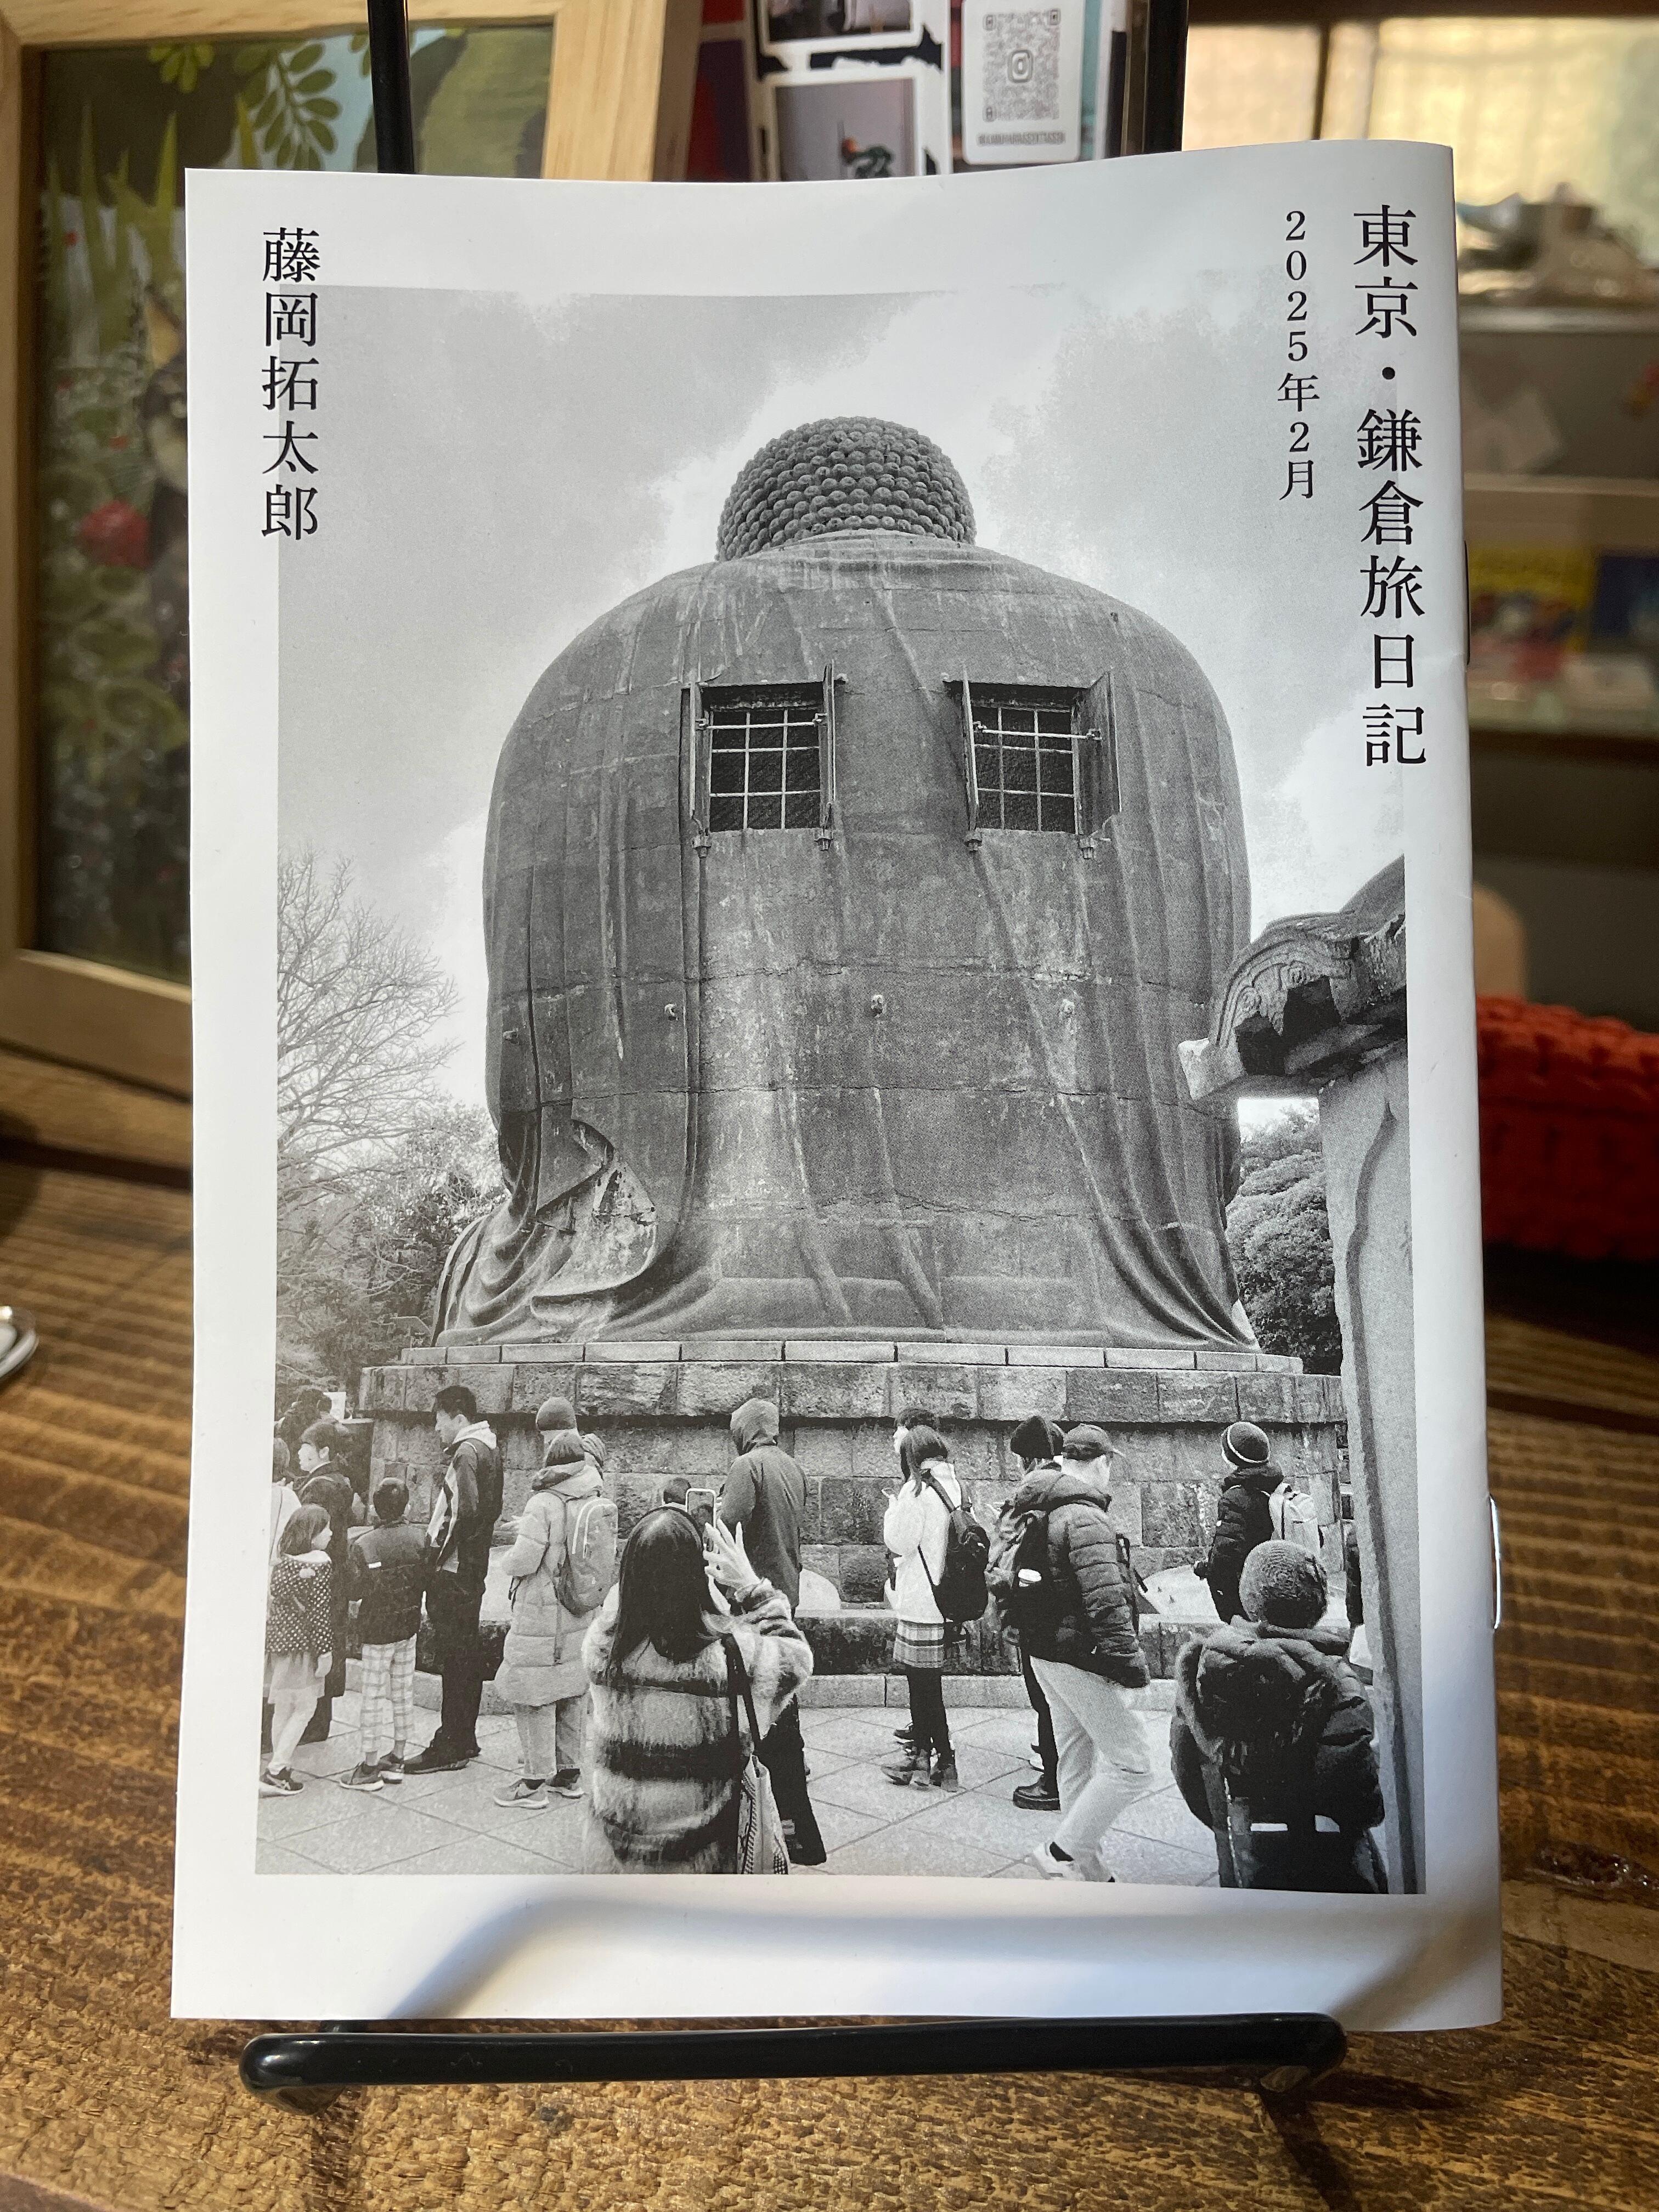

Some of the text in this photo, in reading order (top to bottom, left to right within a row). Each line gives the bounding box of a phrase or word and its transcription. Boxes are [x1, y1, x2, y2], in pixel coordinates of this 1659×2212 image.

[261, 227, 320, 540] 藤岡拓太郎
[1277, 211, 1319, 501] 2025年2月
[1353, 205, 1426, 766] 東京・鎌倉旅日記
